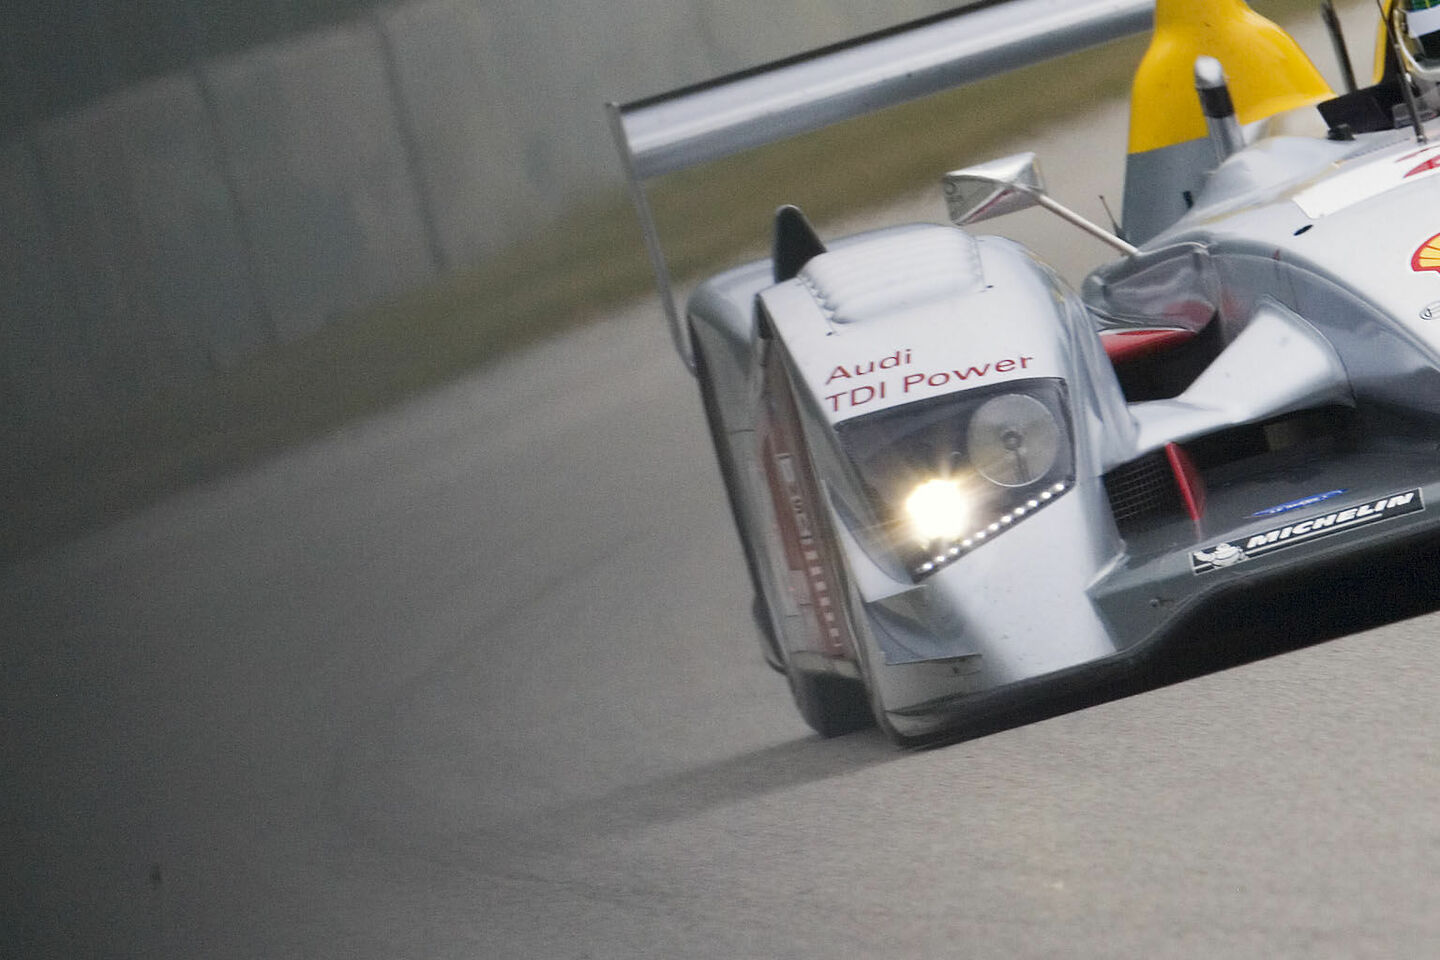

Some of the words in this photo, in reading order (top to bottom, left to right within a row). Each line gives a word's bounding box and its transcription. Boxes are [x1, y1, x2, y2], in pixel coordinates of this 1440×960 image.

[825, 348, 912, 385] Audi
[825, 380, 886, 412] TDI
[903, 354, 1034, 393] Power
[1246, 492, 1414, 549] MICHELIN
